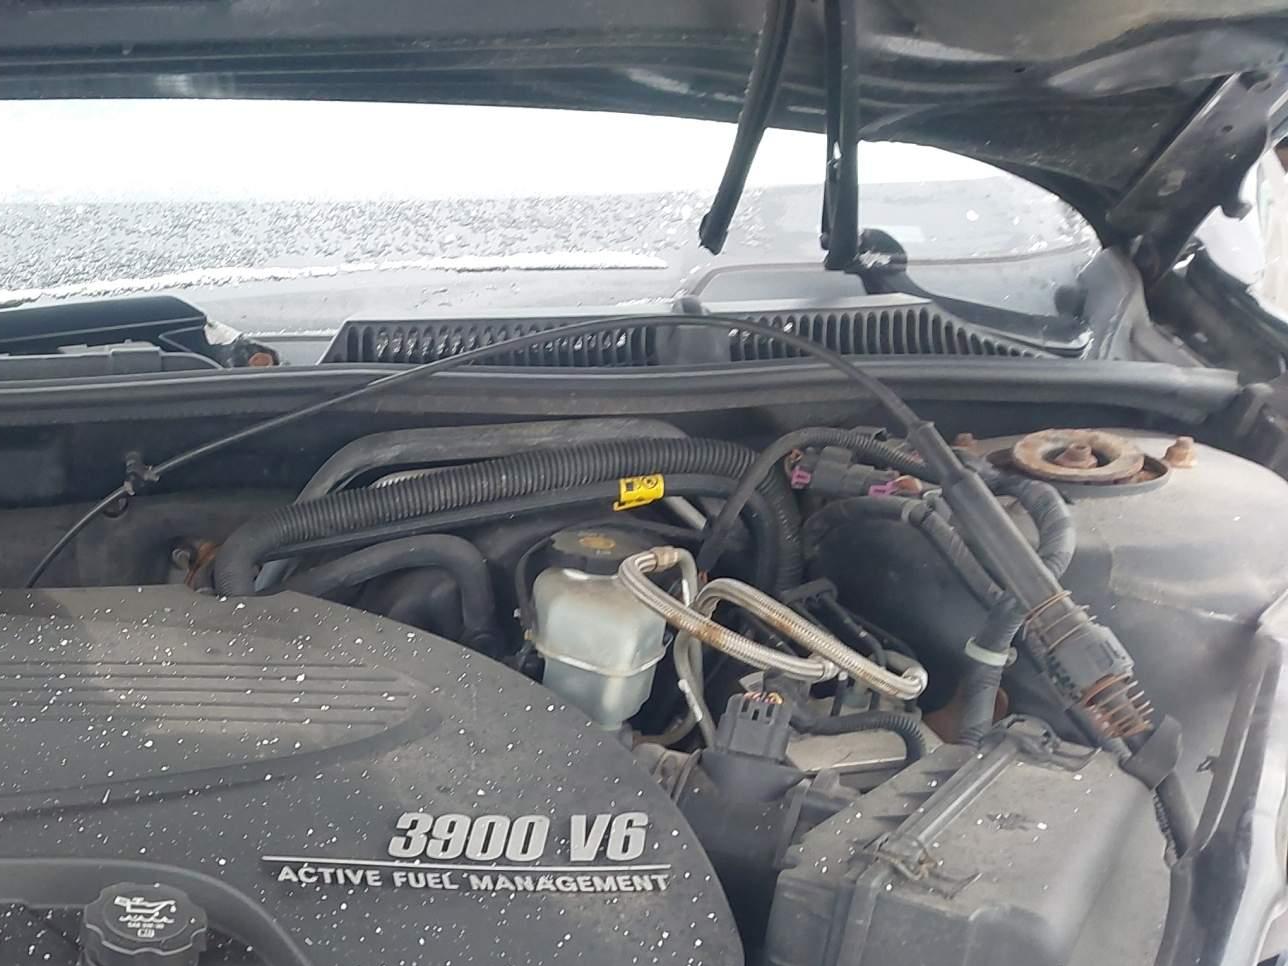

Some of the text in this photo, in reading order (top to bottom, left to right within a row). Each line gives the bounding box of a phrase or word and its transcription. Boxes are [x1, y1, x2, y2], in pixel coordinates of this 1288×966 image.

[387, 811, 649, 862] 3900 V6
[277, 865, 671, 892] ACTIVE FUEL MANAGEMENT
